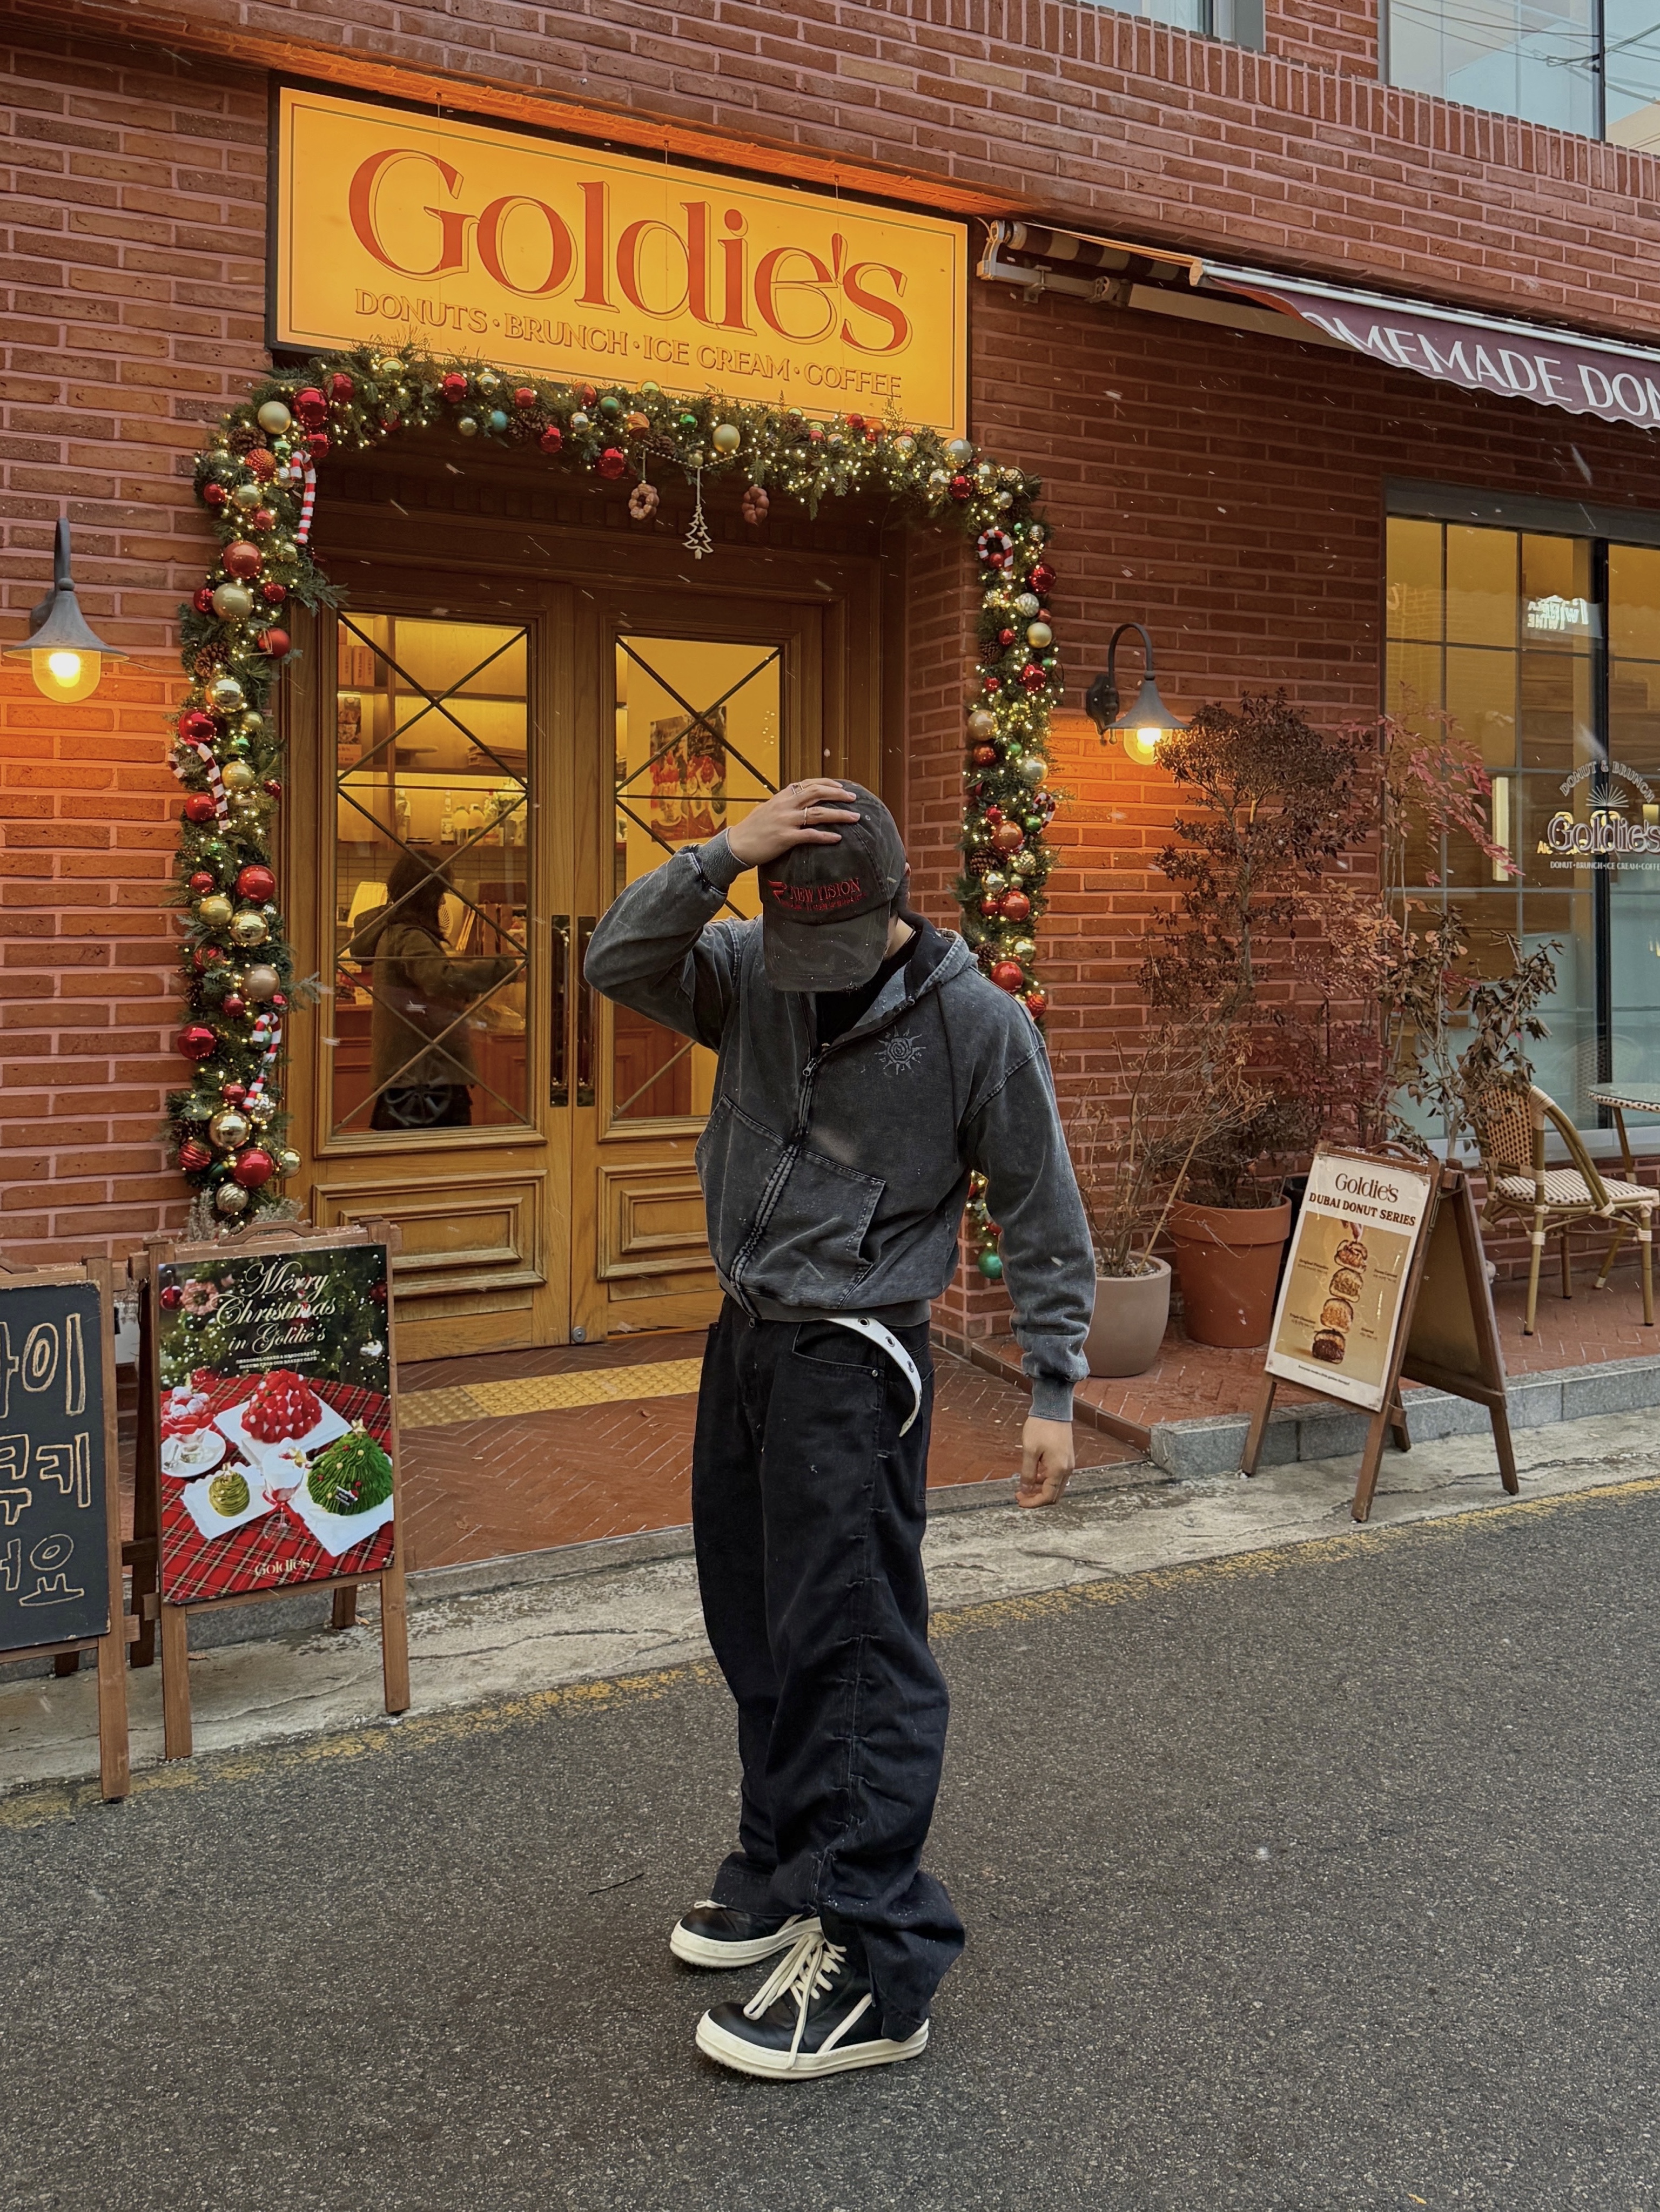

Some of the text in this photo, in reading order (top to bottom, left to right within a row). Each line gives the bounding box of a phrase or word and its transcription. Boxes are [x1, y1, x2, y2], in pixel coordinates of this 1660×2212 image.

[349, 149, 912, 356] Goldie's
[355, 288, 901, 397] DONUTS BRUNCH ICE CREAM COFFEE
[1560, 759, 1655, 803] DONUT & BRUNCH
[1547, 815, 1660, 853] Goldie's
[790, 886, 814, 902] NEW
[817, 878, 861, 901] VISION
[1335, 1173, 1399, 1203] Goldie's
[1308, 1192, 1416, 1226] DUBAI DONUT SERIES
[240, 1261, 331, 1303] Merry
[210, 1293, 336, 1326] Christmas
[228, 1323, 326, 1354] in Goldie's
